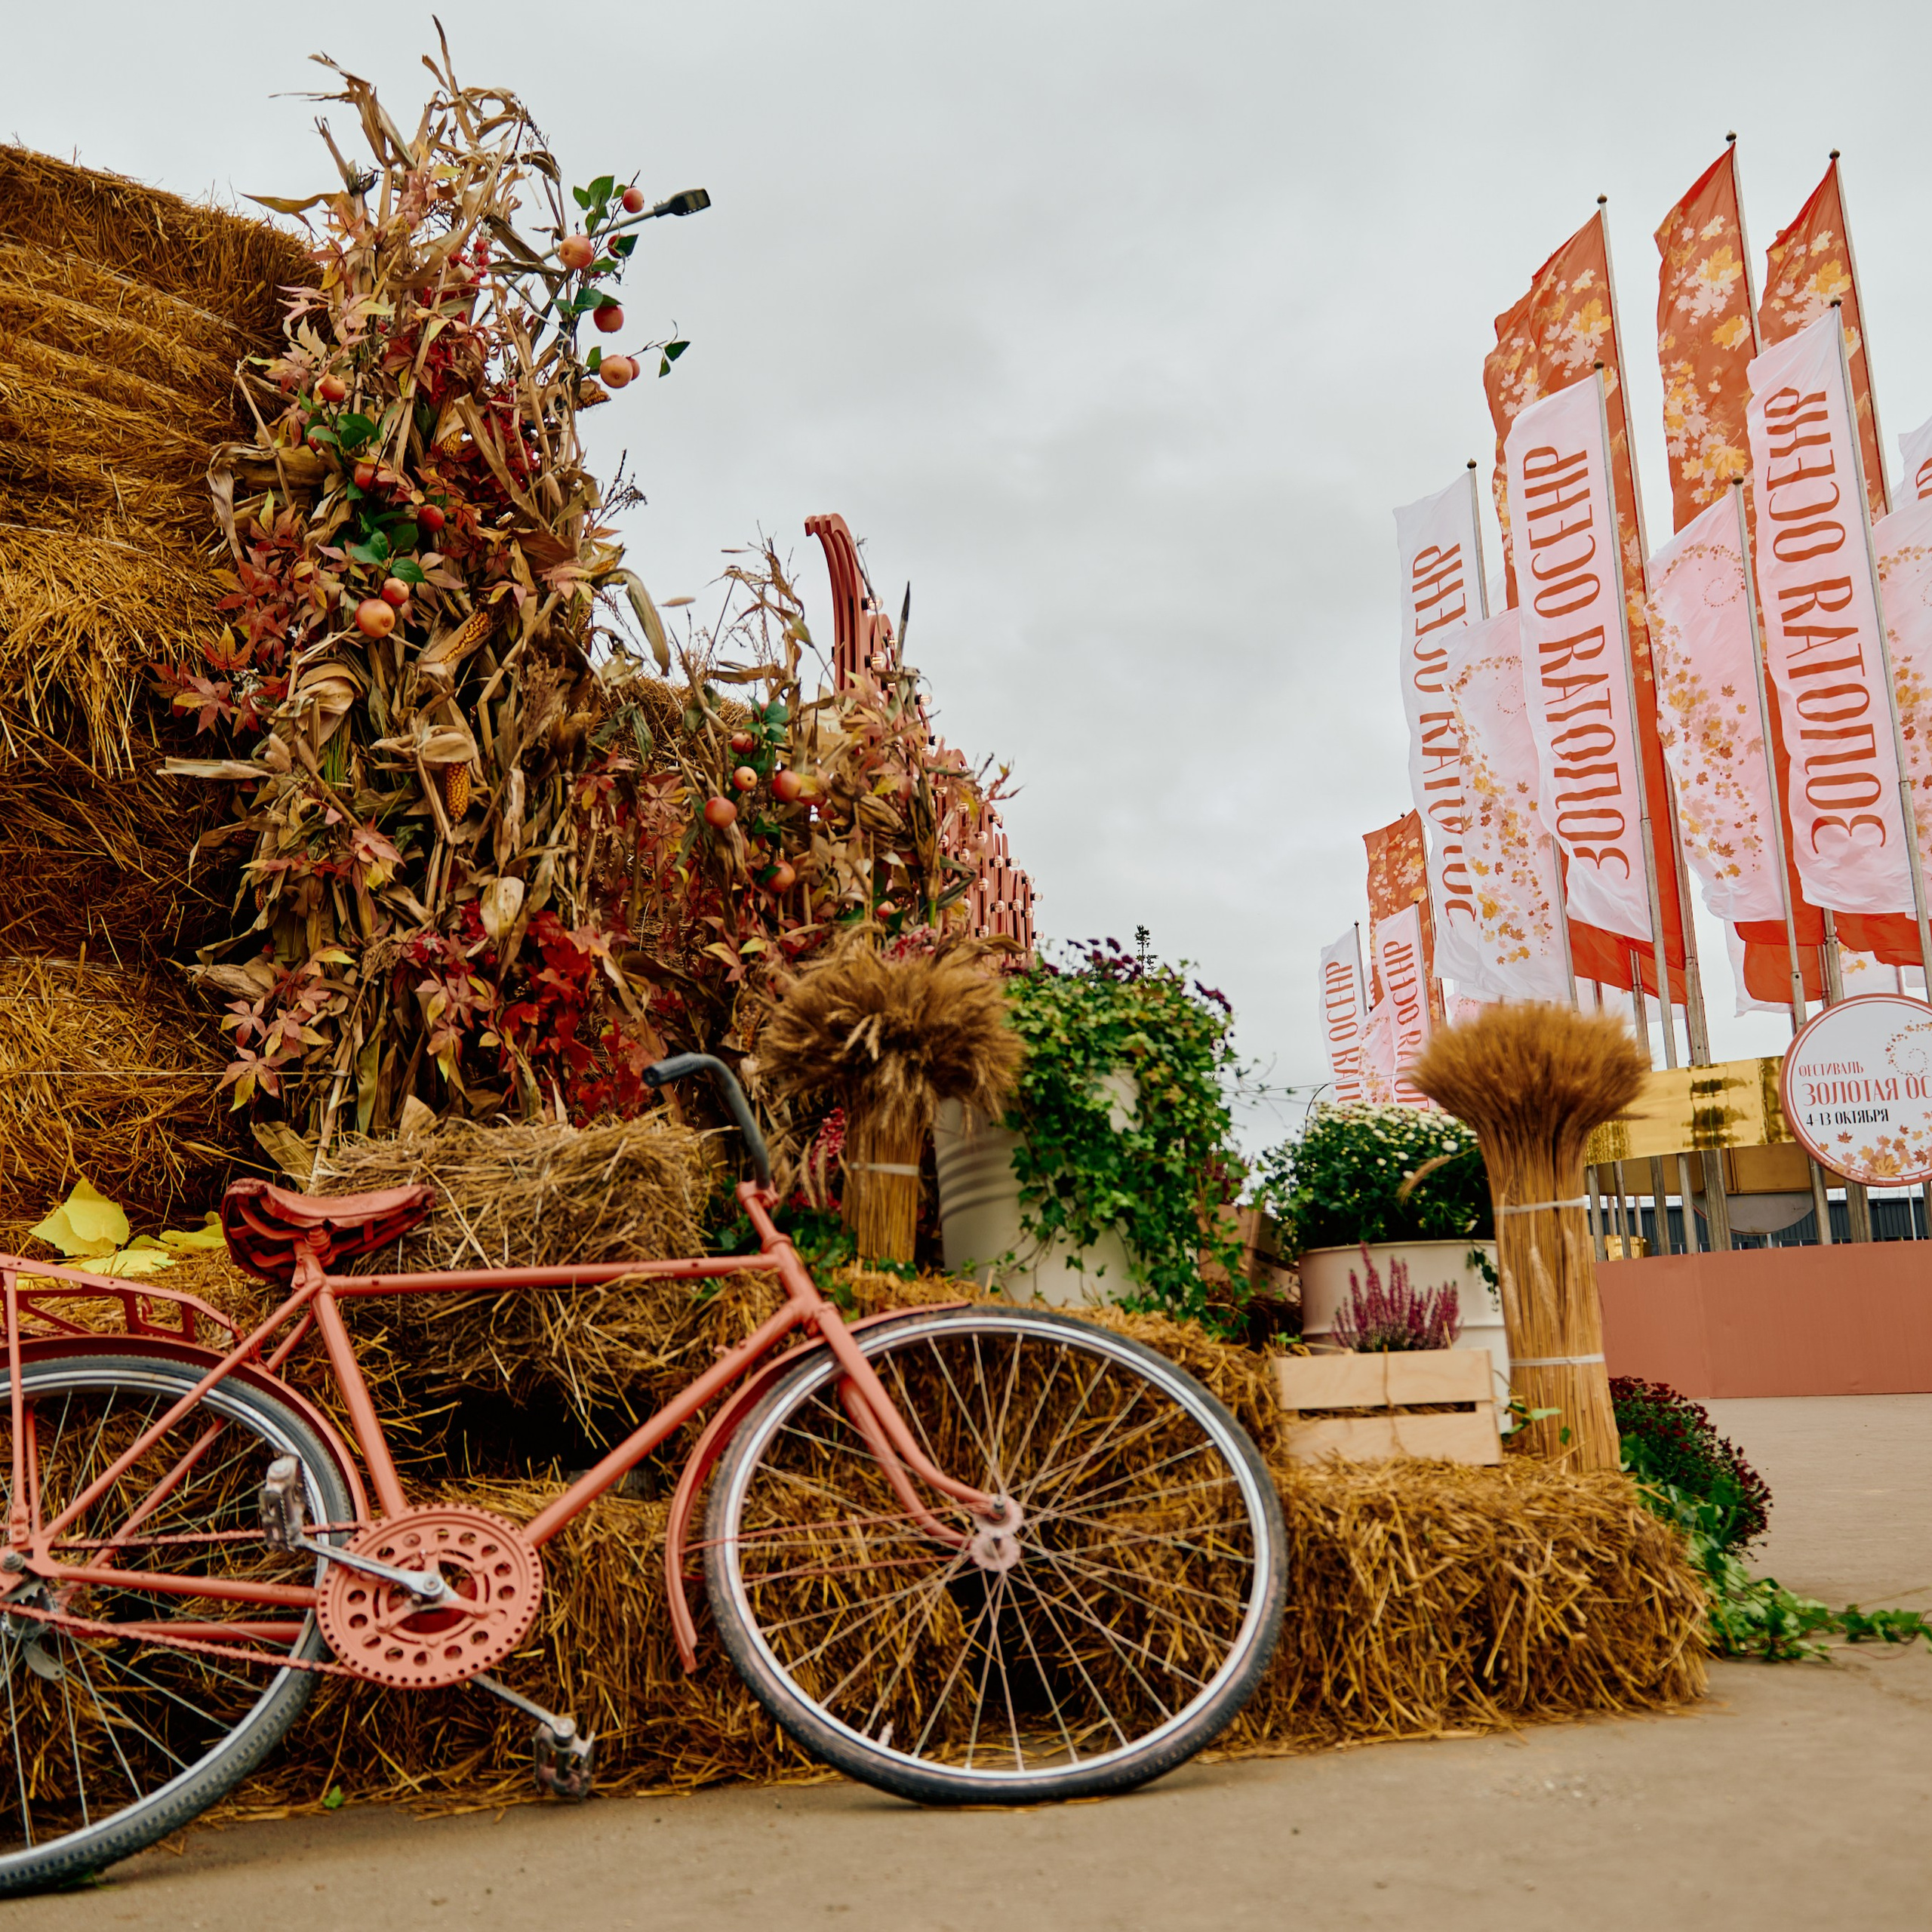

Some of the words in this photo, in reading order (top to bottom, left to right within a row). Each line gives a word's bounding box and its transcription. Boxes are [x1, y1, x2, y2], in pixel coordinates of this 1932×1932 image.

[1798, 1061, 1864, 1078] ФЕСТИВАЛЬ
[1801, 1078, 1899, 1106] ЗОЛОТАЯ
[1835, 1108, 1889, 1124] ОКТЯБРЯ
